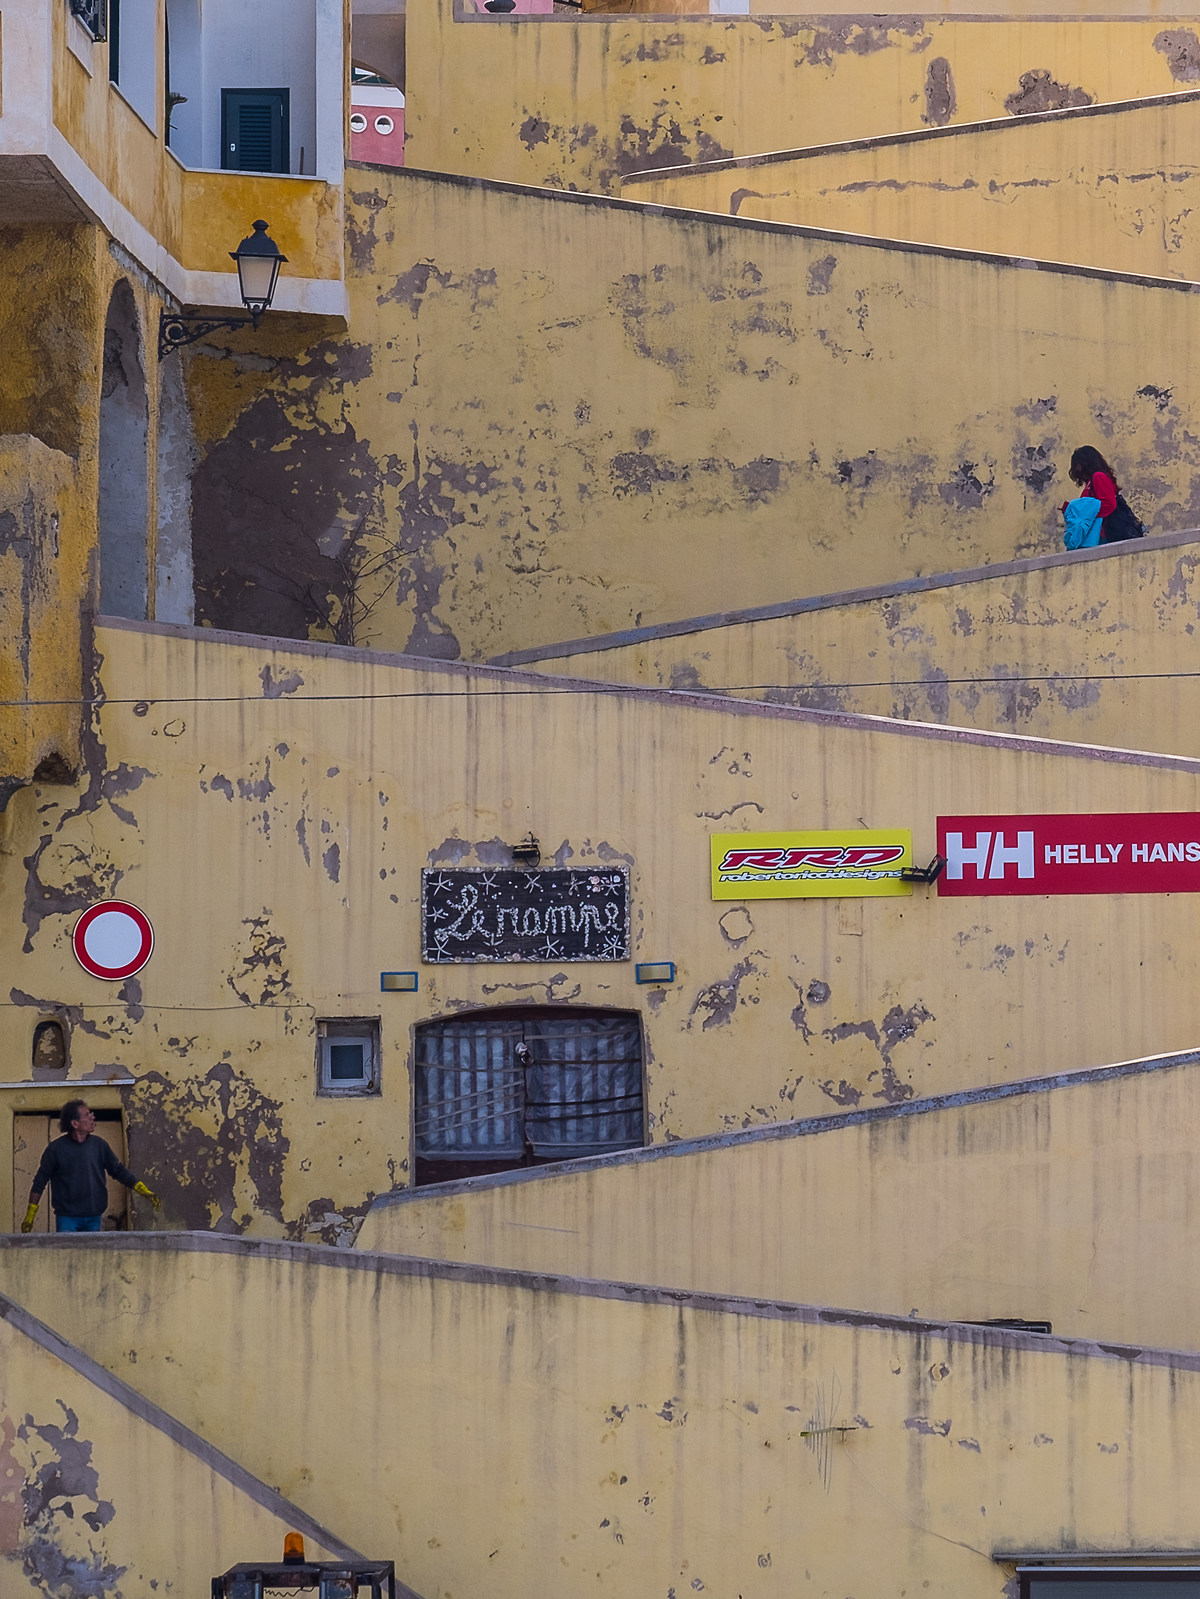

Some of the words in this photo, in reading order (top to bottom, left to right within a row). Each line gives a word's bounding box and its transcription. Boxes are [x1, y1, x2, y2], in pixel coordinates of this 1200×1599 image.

[718, 846, 904, 871] RRD
[1044, 843, 1124, 864] HELLY
[434, 884, 493, 941] Le
[496, 901, 623, 948] rampe
